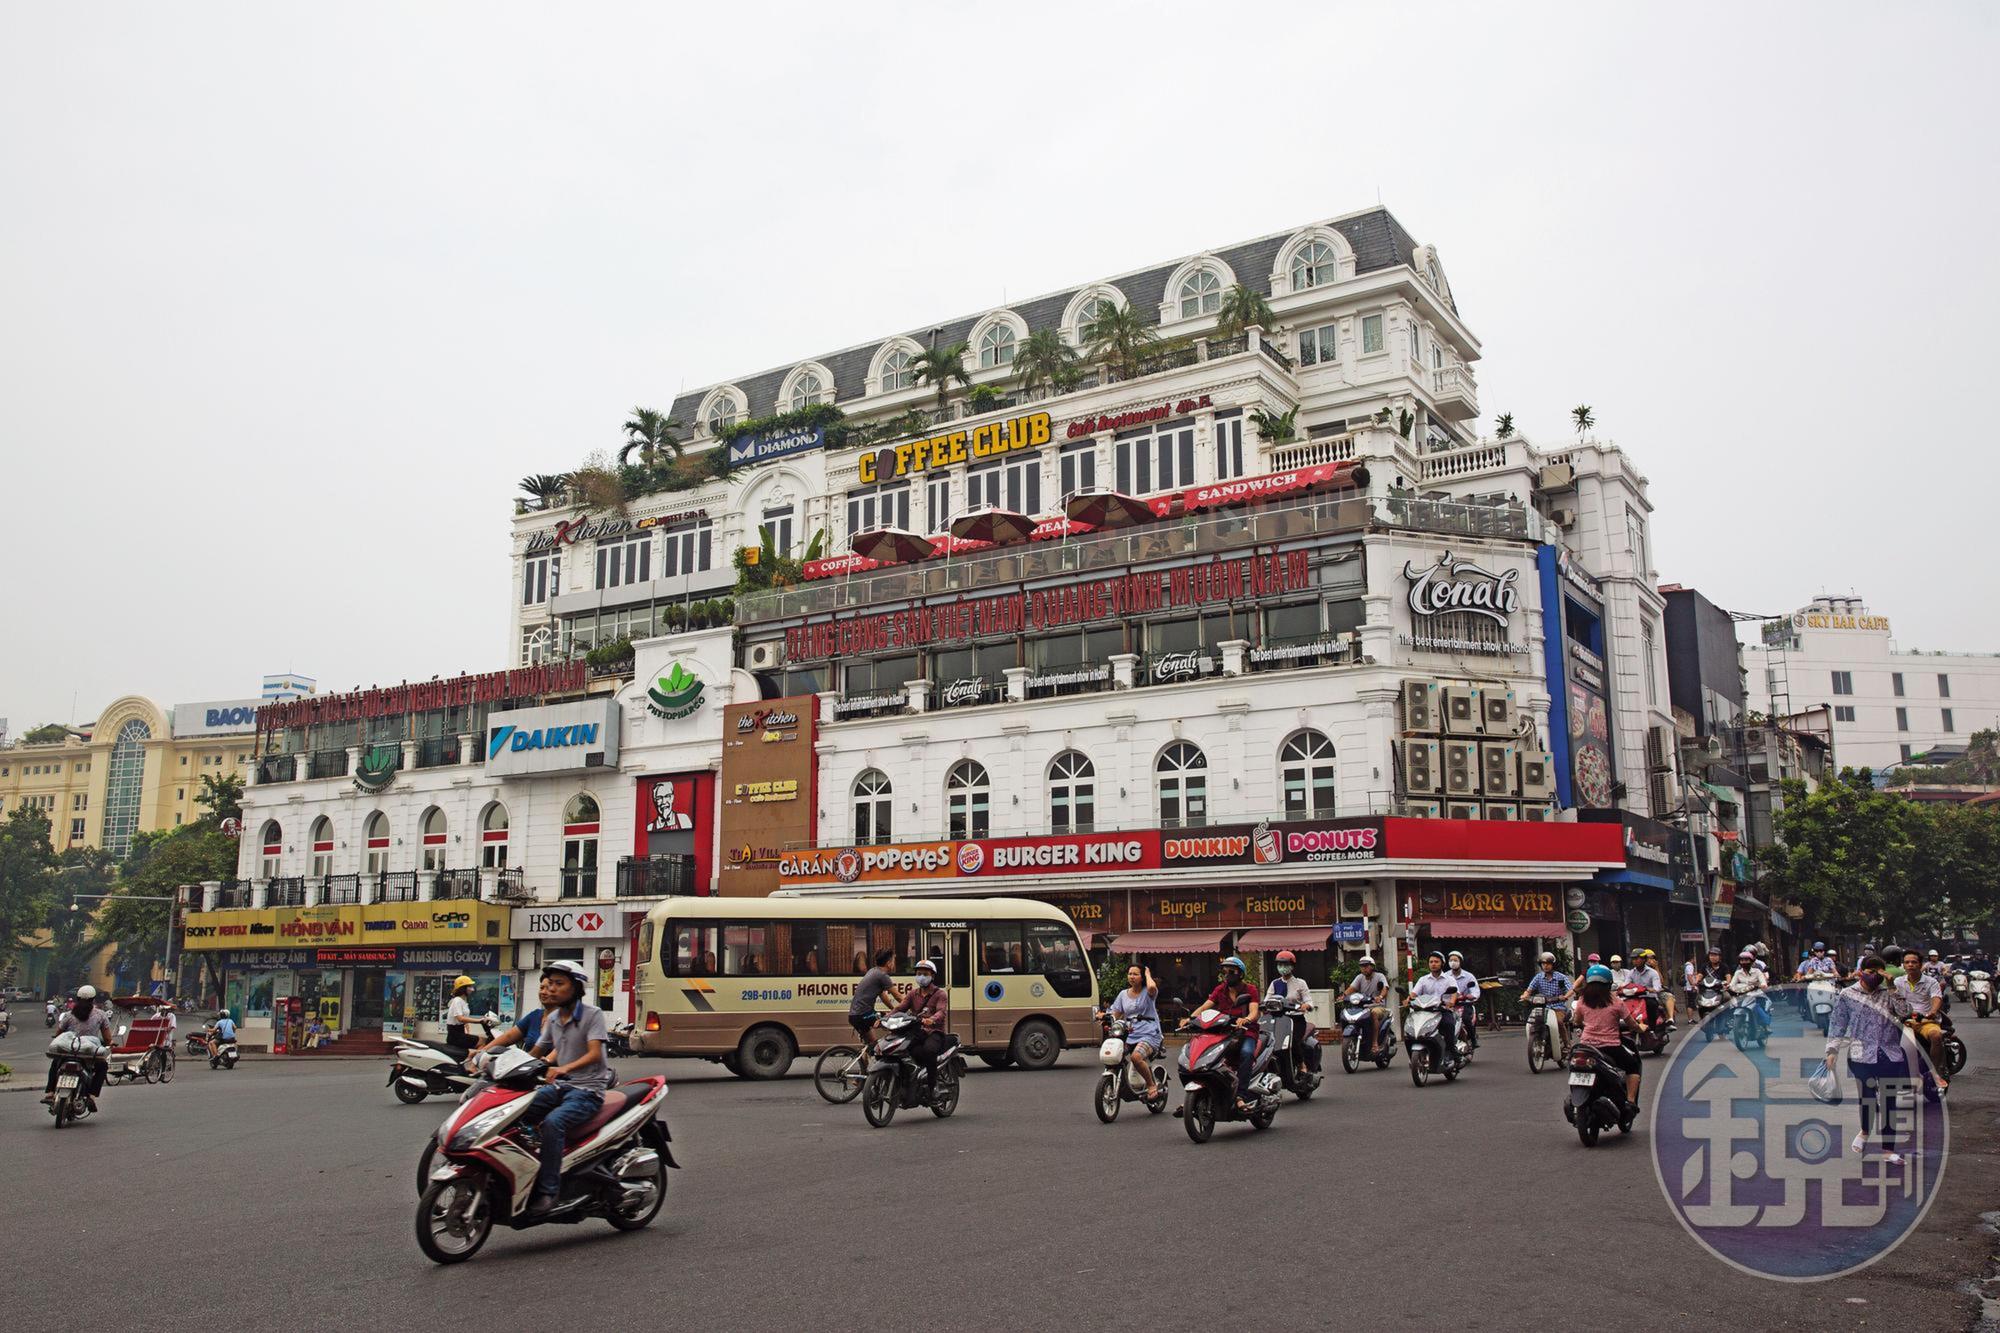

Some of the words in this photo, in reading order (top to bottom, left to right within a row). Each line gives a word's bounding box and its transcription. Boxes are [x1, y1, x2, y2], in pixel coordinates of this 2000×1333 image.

[1066, 419, 1096, 439] Café
[1097, 402, 1171, 432] Restaurant
[758, 432, 818, 456] DIAMOND
[858, 430, 967, 484] COFFEE
[972, 411, 1051, 459] CLUB
[1197, 473, 1298, 501] SANDWICH
[525, 531, 554, 551] the
[553, 515, 634, 547] Kitchen
[820, 557, 863, 572] COFFEE
[892, 600, 933, 648] SẢN
[978, 593, 1026, 635] NAM
[1031, 582, 1107, 632] QUANG
[1110, 572, 1163, 616] VINH
[1169, 553, 1244, 608] MUÔN
[1250, 544, 1309, 597] NĂM
[1807, 615, 1831, 629] SKY
[1832, 615, 1856, 630] BAR
[1250, 648, 1260, 662] The
[1260, 647, 1273, 661] best
[1273, 643, 1311, 660] entertainment
[1311, 642, 1326, 655] show
[1415, 635, 1432, 647] best
[1432, 636, 1482, 650] entertainment
[1483, 640, 1502, 652] show
[1044, 671, 1077, 687] entertainment
[205, 706, 257, 728] BAOV
[737, 714, 754, 728] the
[754, 707, 798, 730] Kitchen
[510, 722, 600, 753] DAIKIN
[1164, 835, 1250, 859] DUNKIN'
[1288, 828, 1378, 853] DONUTS
[962, 853, 980, 866] KING
[993, 843, 1080, 868] BURGER
[1084, 841, 1142, 866] KING
[1160, 899, 1208, 919] Burger
[1246, 895, 1306, 913] Fastfood
[280, 917, 323, 937] HỒNG
[323, 918, 355, 936] VÂN
[401, 919, 429, 930] Canon
[432, 911, 470, 923] GoPro
[529, 913, 573, 933] HSBC
[186, 926, 217, 937] SONY
[218, 925, 248, 937] PENTAX
[250, 922, 275, 935] Nikon
[402, 951, 453, 964] SAMSUNG
[453, 951, 492, 966] Galaxy
[741, 989, 792, 1001] 29B-010.60
[797, 983, 849, 997] HALONG
